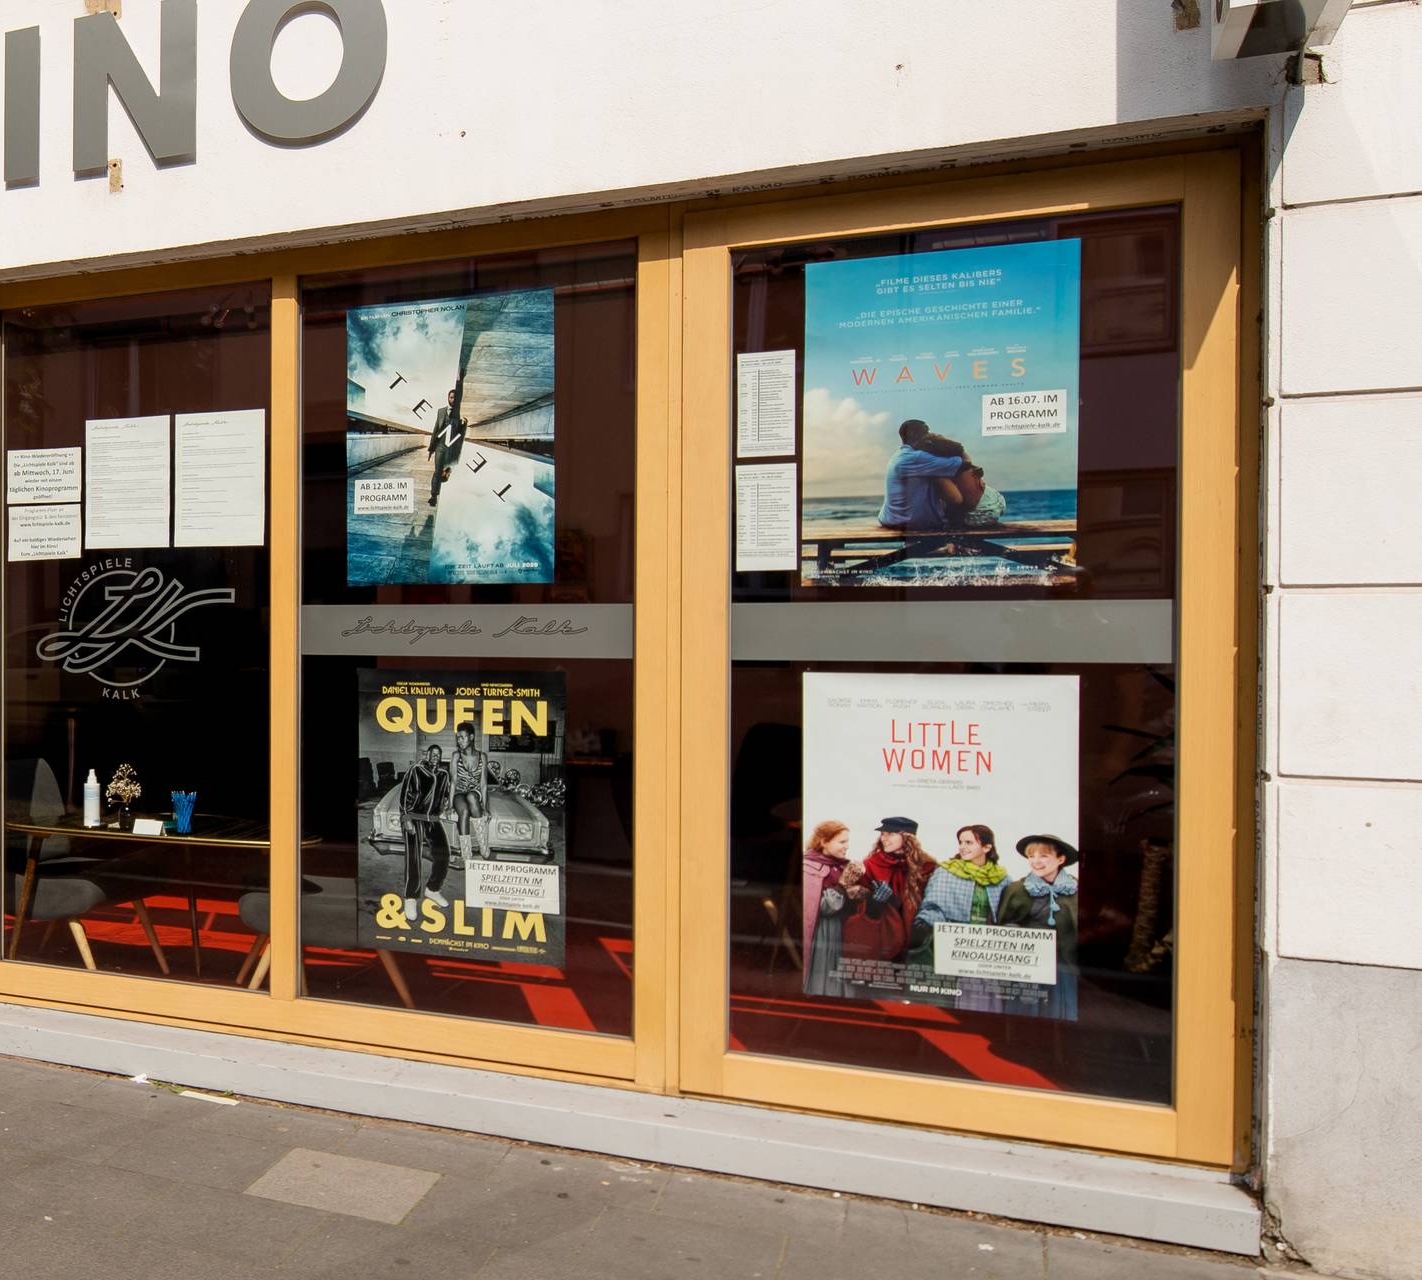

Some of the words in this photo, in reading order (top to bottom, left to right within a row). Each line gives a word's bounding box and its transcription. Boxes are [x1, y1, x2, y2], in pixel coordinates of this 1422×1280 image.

[913, 274, 948, 284] DIESES
[952, 269, 1003, 280] KALIBERS
[876, 287, 899, 295] GIBT
[902, 285, 915, 293] ES
[918, 282, 956, 292] SELTEN
[959, 280, 975, 288] BIS
[391, 307, 439, 317] CHRISTOPHER
[440, 304, 465, 313] NOLAN
[880, 307, 921, 318] EPISCHE
[925, 302, 988, 313] GESCHICHTE
[992, 299, 1024, 308] EINER
[838, 318, 895, 329] MODERNEN
[897, 311, 989, 324] AMERIKANISCHEN
[851, 357, 1027, 385] WAVES
[990, 397, 1005, 406] AB
[1008, 395, 1041, 405] 16.07.
[1043, 394, 1058, 403] IM
[990, 409, 1058, 420] PROGRAMM
[373, 482, 395, 490] 12.08.
[360, 494, 408, 502] PROGRAMM
[58, 557, 132, 622] LICHTSPIELE
[492, 615, 588, 639] Kalk
[102, 687, 140, 700] KALK
[382, 686, 409, 695] DANIEL
[411, 686, 445, 696] KALUUYA
[454, 687, 480, 696] JODIE
[483, 687, 540, 697] TURNER-SMITH
[376, 696, 548, 737] QUEEN
[891, 719, 982, 747] LITTLE
[882, 748, 993, 775] WOMEN
[469, 862, 490, 871] JETZT
[506, 865, 557, 876] PROGRAMM
[481, 874, 530, 885] SPIELZEITEN
[531, 878, 543, 886] IM
[479, 885, 540, 897] KINOAUSHANG
[375, 893, 412, 930] &
[420, 898, 546, 943] SLIM
[937, 924, 966, 934] JETZT
[969, 926, 983, 935] IM
[986, 927, 1053, 941] PROGRAMM
[473, 940, 490, 949] KINO
[954, 938, 1018, 950] SPIELZEITEN
[1020, 943, 1035, 951] IM
[951, 950, 1031, 965] KINOAUSHANG
[910, 984, 928, 994] NUR
[929, 986, 939, 994] IM
[941, 987, 963, 997] KINO
